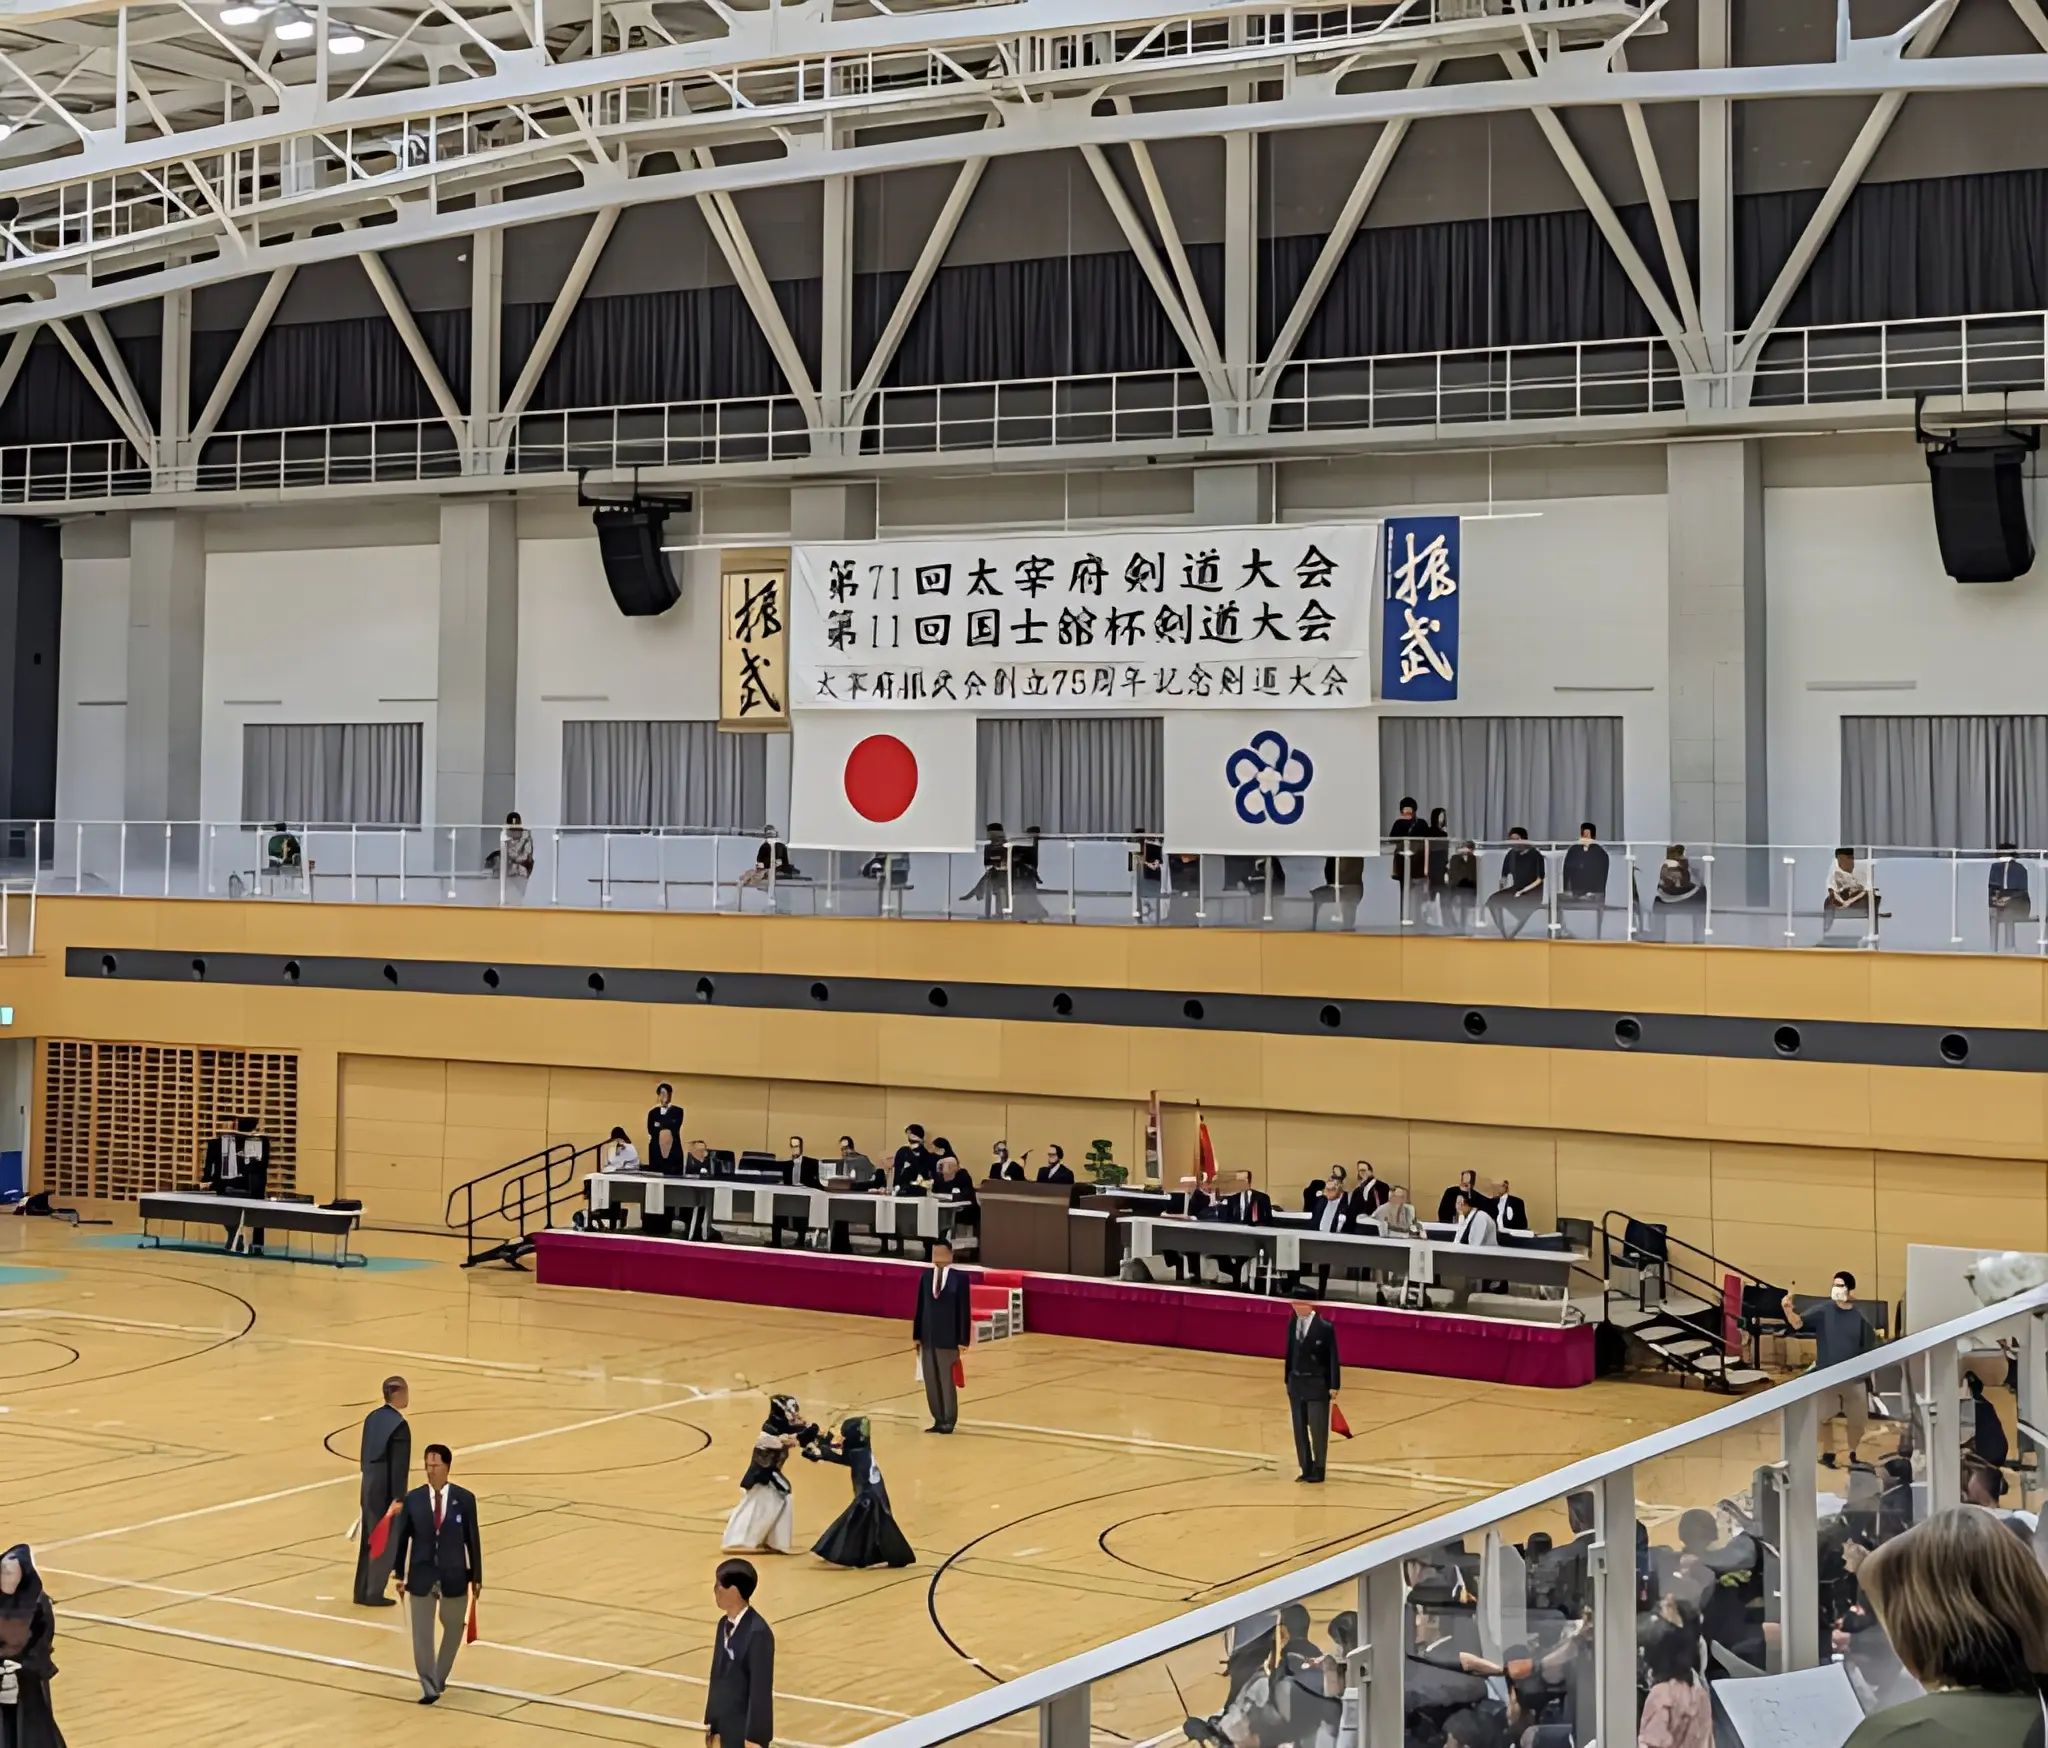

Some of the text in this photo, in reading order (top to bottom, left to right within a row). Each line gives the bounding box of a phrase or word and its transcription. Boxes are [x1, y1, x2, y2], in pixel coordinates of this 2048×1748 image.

[829, 544, 1339, 603] 第71回太宰府剣道大会
